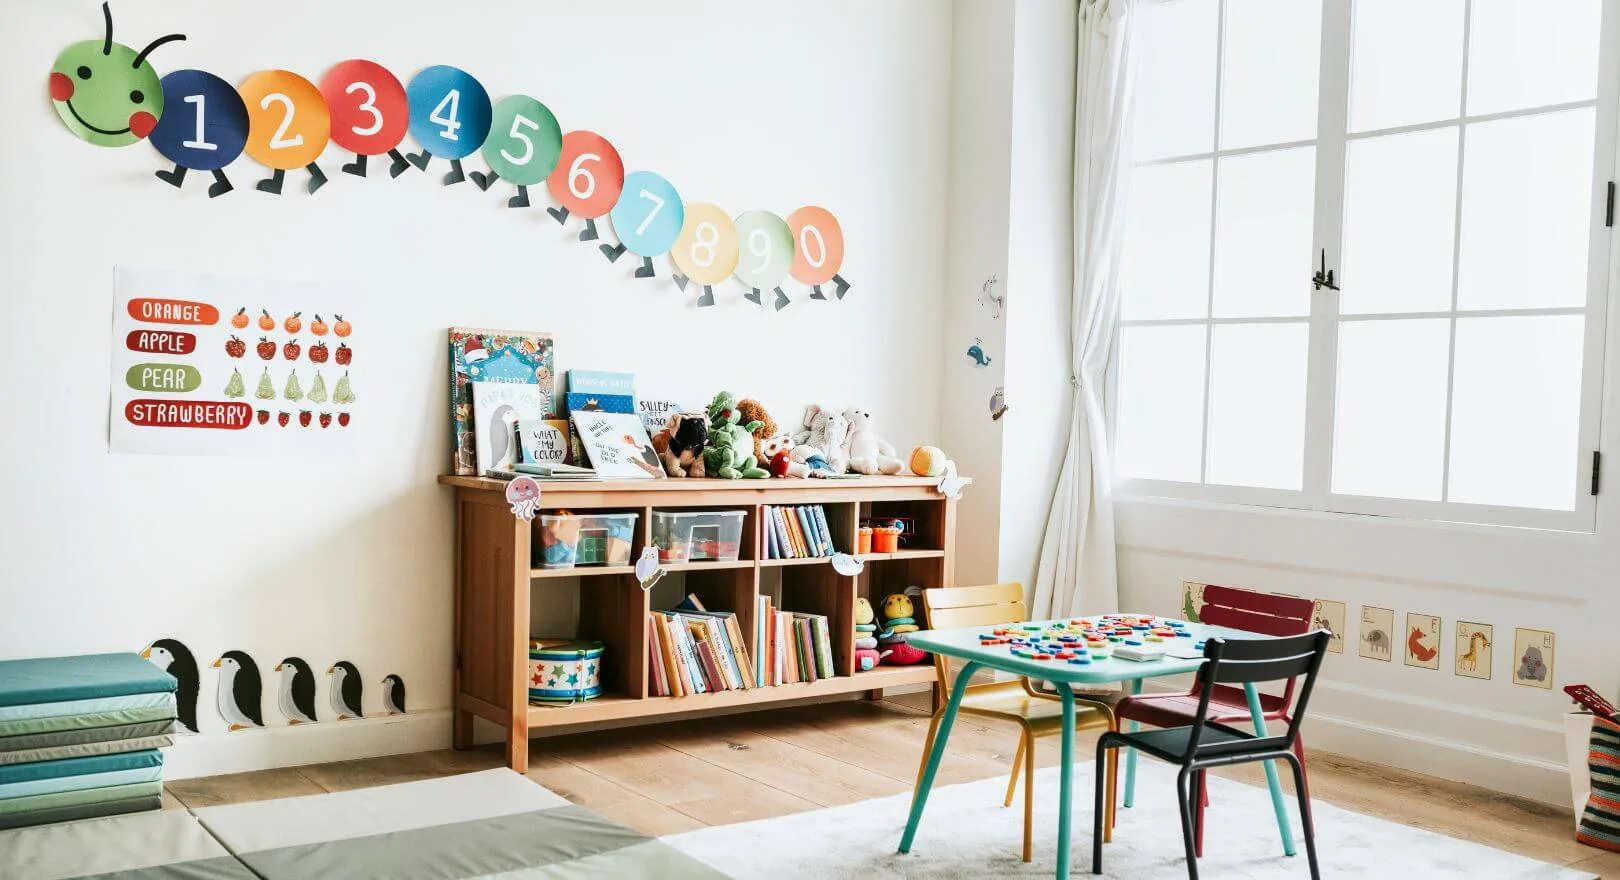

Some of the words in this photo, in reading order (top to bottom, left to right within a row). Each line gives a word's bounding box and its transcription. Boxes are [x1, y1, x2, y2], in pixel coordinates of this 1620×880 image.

[182, 94, 218, 150] 1
[260, 93, 304, 149] 2
[345, 82, 384, 136] 3
[429, 89, 461, 141] 4
[499, 113, 539, 166] 5
[568, 153, 601, 199] 6
[636, 189, 665, 236] 7
[690, 222, 719, 267] 8
[748, 229, 772, 273] 9
[800, 225, 826, 268] 0
[142, 302, 201, 322] ORANGE
[139, 332, 185, 353] APPLE
[142, 368, 186, 389] PEAR
[132, 404, 247, 426] STRAWBERRY
[533, 430, 557, 440] WHAT
[541, 439, 554, 450] MY
[533, 449, 564, 460] COLOR?
[1363, 607, 1370, 619] E
[1431, 618, 1438, 632] F
[1543, 634, 1551, 646] H
